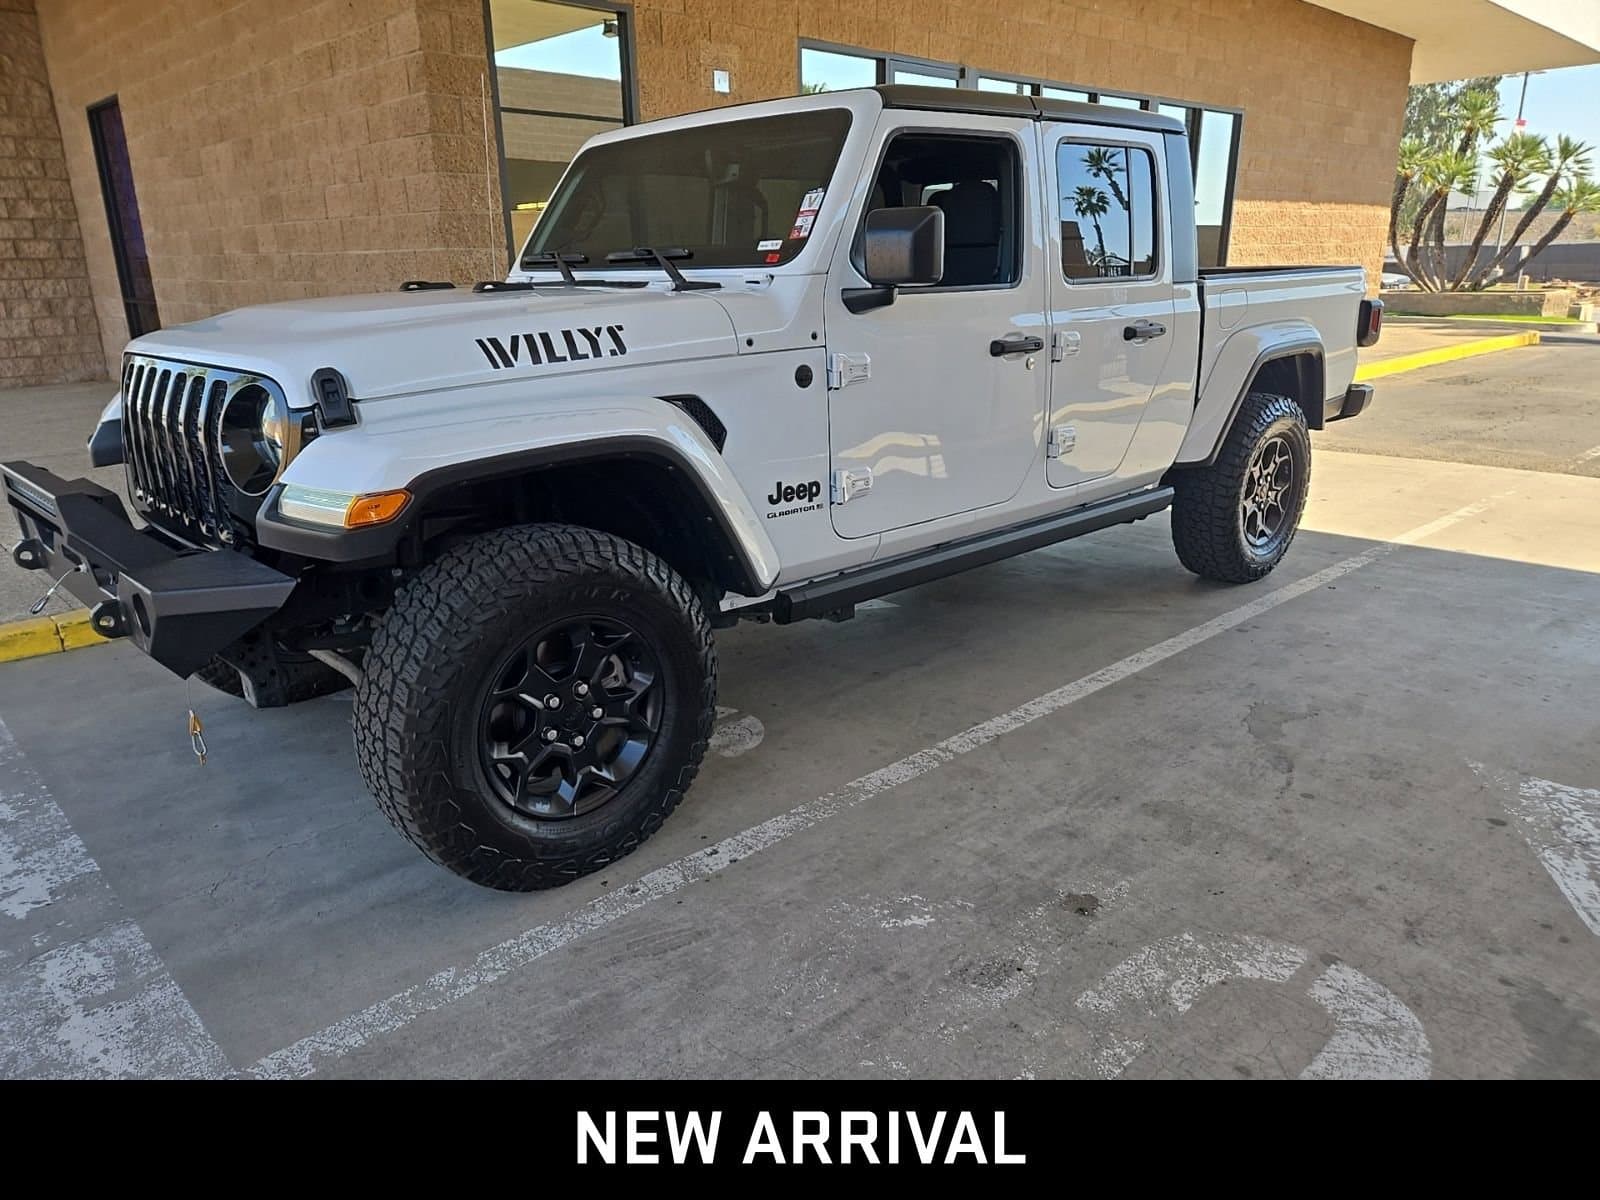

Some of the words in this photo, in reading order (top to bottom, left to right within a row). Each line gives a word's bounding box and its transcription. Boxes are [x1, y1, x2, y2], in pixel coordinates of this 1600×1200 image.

[475, 325, 627, 369] WILLYS
[768, 481, 821, 505] Jeep
[767, 505, 815, 519] GLADIATOR
